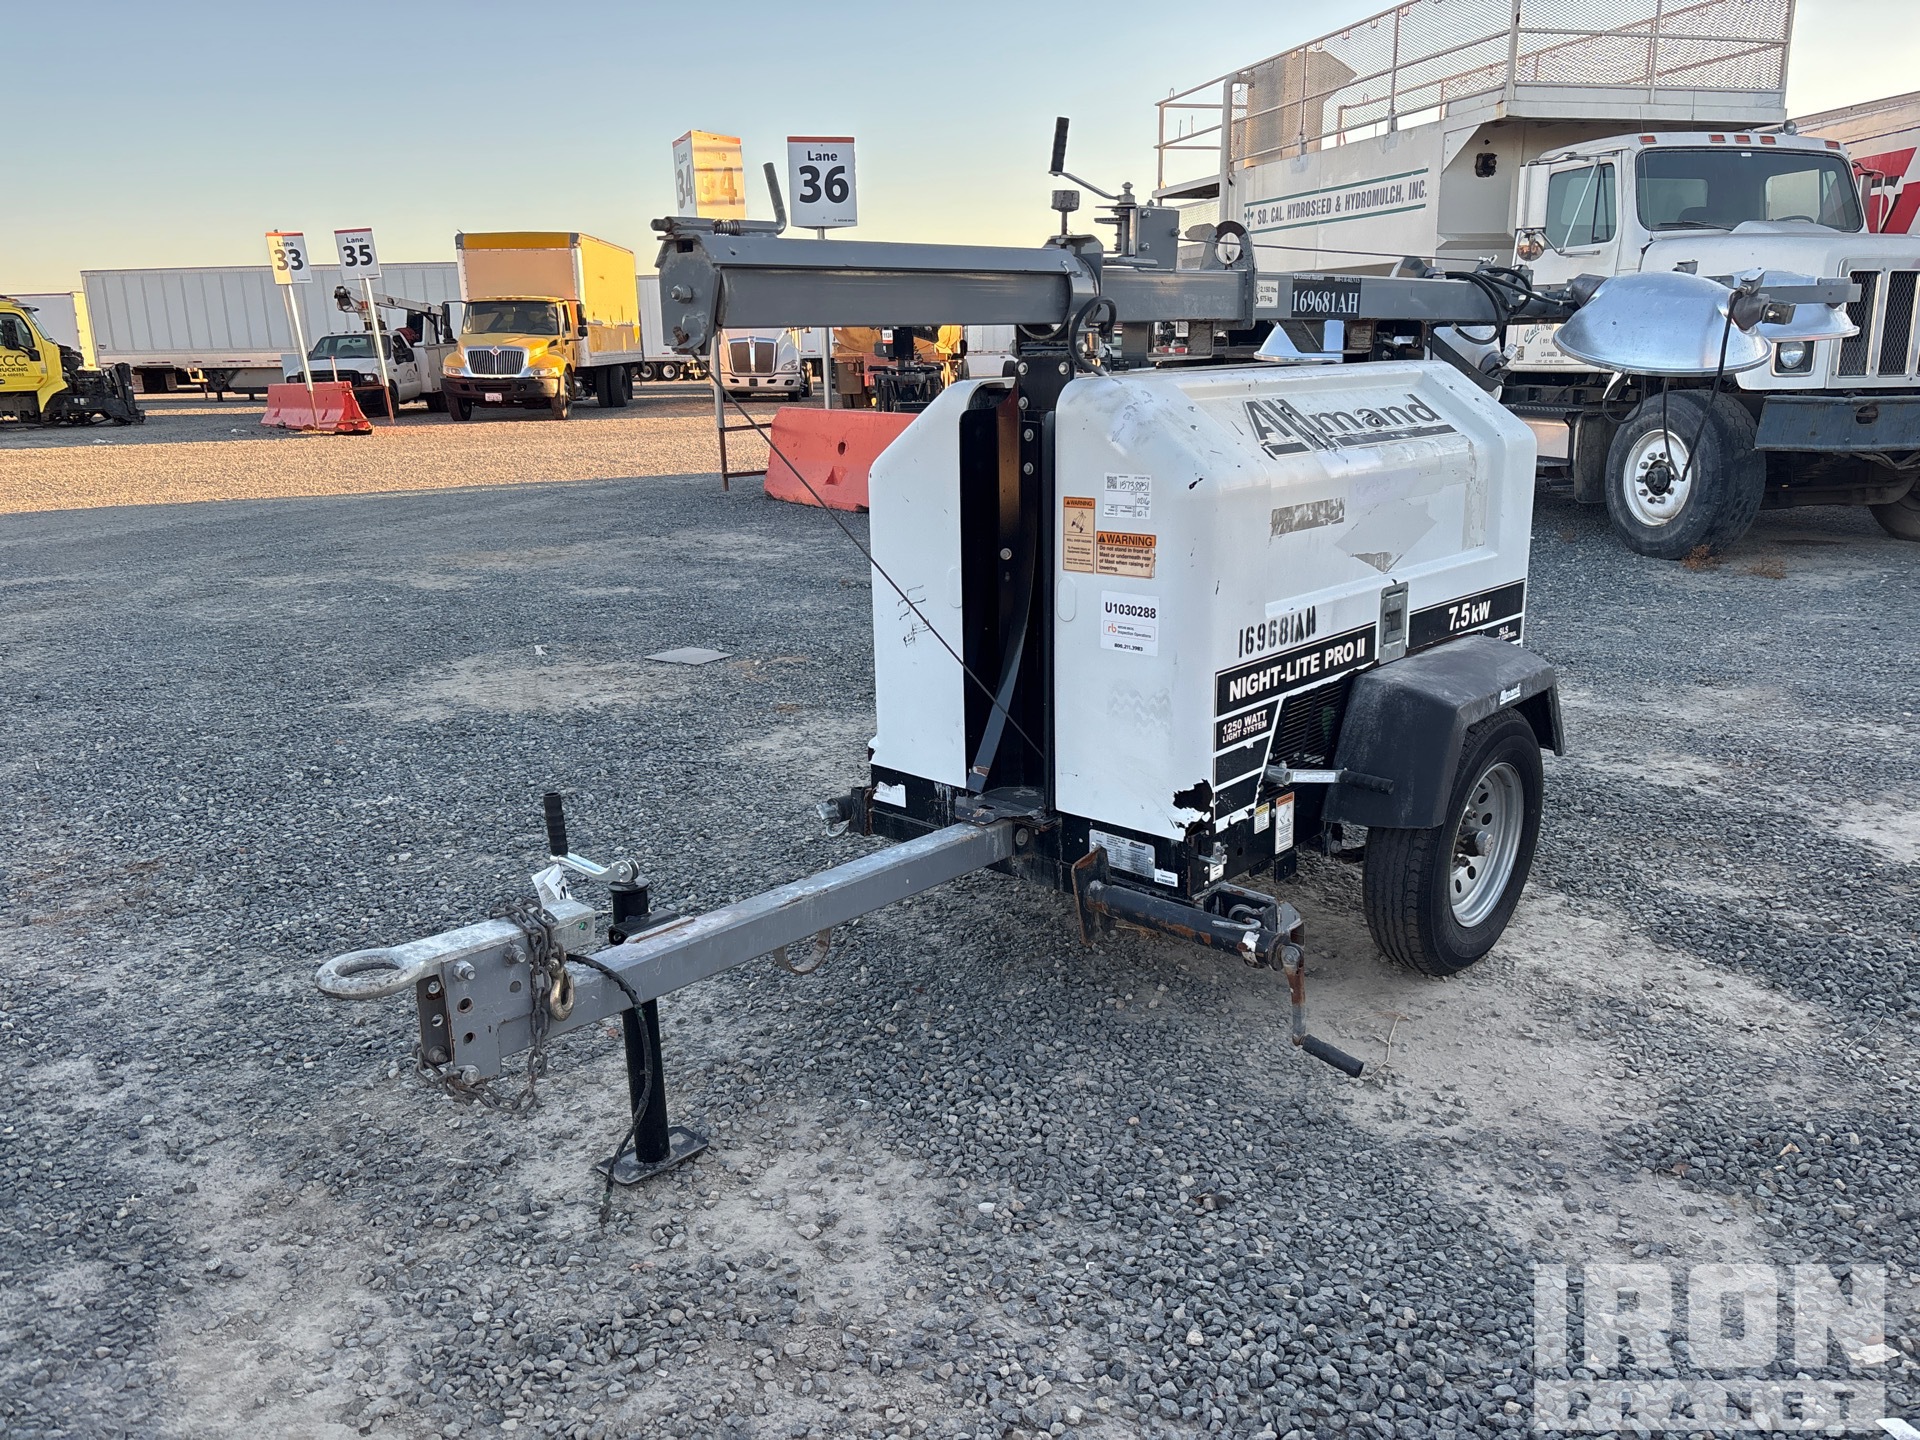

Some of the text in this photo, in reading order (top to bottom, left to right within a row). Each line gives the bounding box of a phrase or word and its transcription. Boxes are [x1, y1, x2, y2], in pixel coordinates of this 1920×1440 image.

[677, 152, 688, 165] Lane
[808, 151, 838, 162] Lane
[676, 165, 693, 209] 34
[799, 165, 850, 204] 36
[1257, 179, 1427, 225] SO. CAL. HYDROSEED & HYDROMULCH, INC.
[346, 236, 364, 244] Lane
[274, 249, 304, 271] 33
[343, 244, 373, 267] 35
[1292, 290, 1359, 313] 169681AH
[0, 355, 27, 367] CC
[1106, 534, 1153, 546] WARNING
[1105, 602, 1156, 619] U1030288
[1108, 623, 1117, 633] rb
[1229, 637, 1366, 702] NIGHT-LITE PRO II
[1222, 710, 1267, 734] 1250 WATT
[1222, 720, 1267, 743] LIGHT SYSTEM
